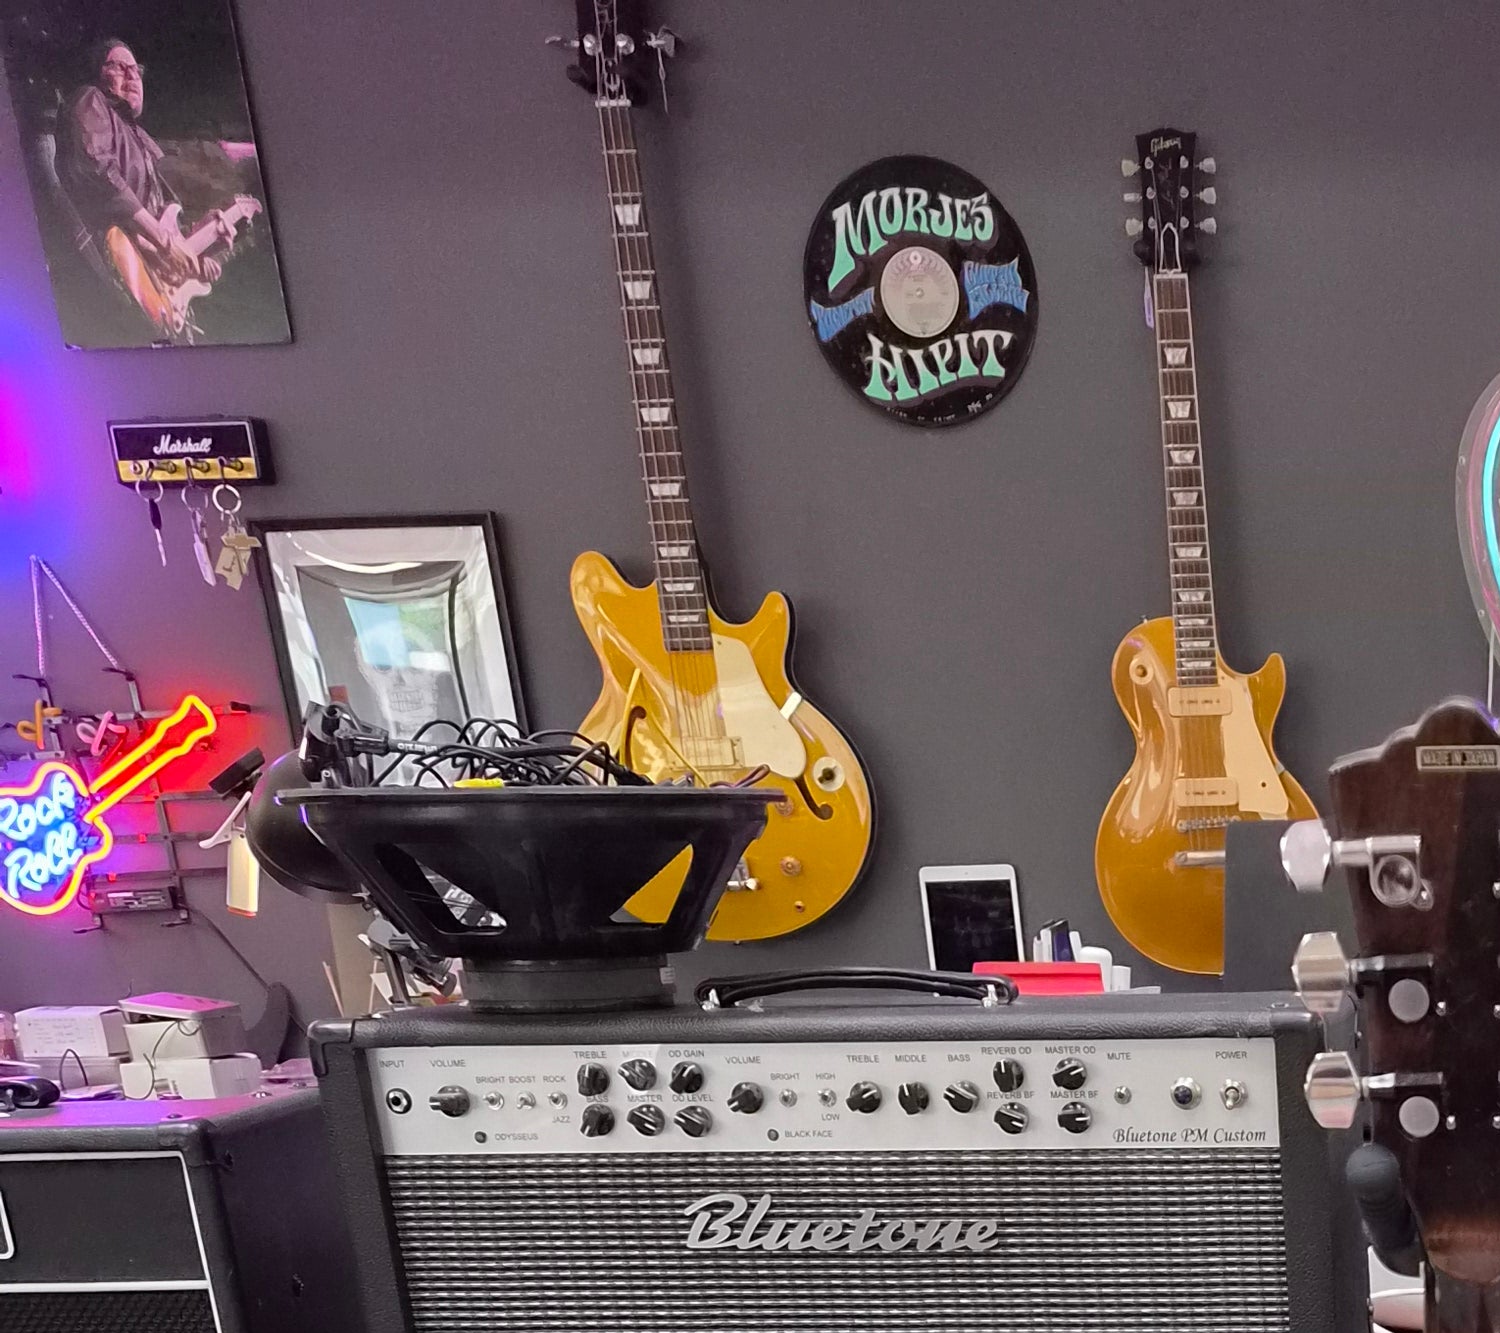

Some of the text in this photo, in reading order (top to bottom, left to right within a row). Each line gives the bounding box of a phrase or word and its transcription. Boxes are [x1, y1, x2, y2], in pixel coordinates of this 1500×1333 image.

[828, 186, 994, 293] MORJES
[864, 330, 1014, 400] HIPIT
[153, 434, 212, 455] Marshall
[1421, 750, 1497, 766] MADE IN JAPAN
[668, 1049, 705, 1058] OD GAIN
[981, 1046, 1032, 1055] REVERB OD
[1045, 1045, 1096, 1055] MASTER OD
[573, 1051, 607, 1059] TREBLE
[725, 1055, 761, 1064] VOLUME
[846, 1054, 880, 1063] TREBLE
[894, 1054, 927, 1063] MIDDLE
[947, 1053, 971, 1062] BASS
[1107, 1052, 1132, 1061] MUTE
[1215, 1050, 1248, 1060] POWER
[378, 1059, 405, 1068] INPUT
[429, 1059, 466, 1068] VOLUME
[475, 1075, 506, 1084] BRIGHT
[508, 1075, 536, 1084] BOOST
[543, 1075, 566, 1083] ROCK
[770, 1072, 800, 1081] BRIGHT
[815, 1072, 836, 1080] HIGH
[586, 1095, 609, 1103] BASS
[627, 1094, 663, 1102] MASTER
[672, 1094, 713, 1102] OD LEVEL
[987, 1090, 1035, 1100] REVERB BF
[1050, 1090, 1099, 1099] MASTER BF
[551, 1115, 571, 1124] JAZZ
[821, 1113, 840, 1121] LOW
[494, 1133, 539, 1141] ODYSSEUS
[784, 1130, 833, 1138] BLACK FACE
[1112, 1126, 1266, 1144] Bluetone PM Custom
[683, 1193, 999, 1251] Bluetone
